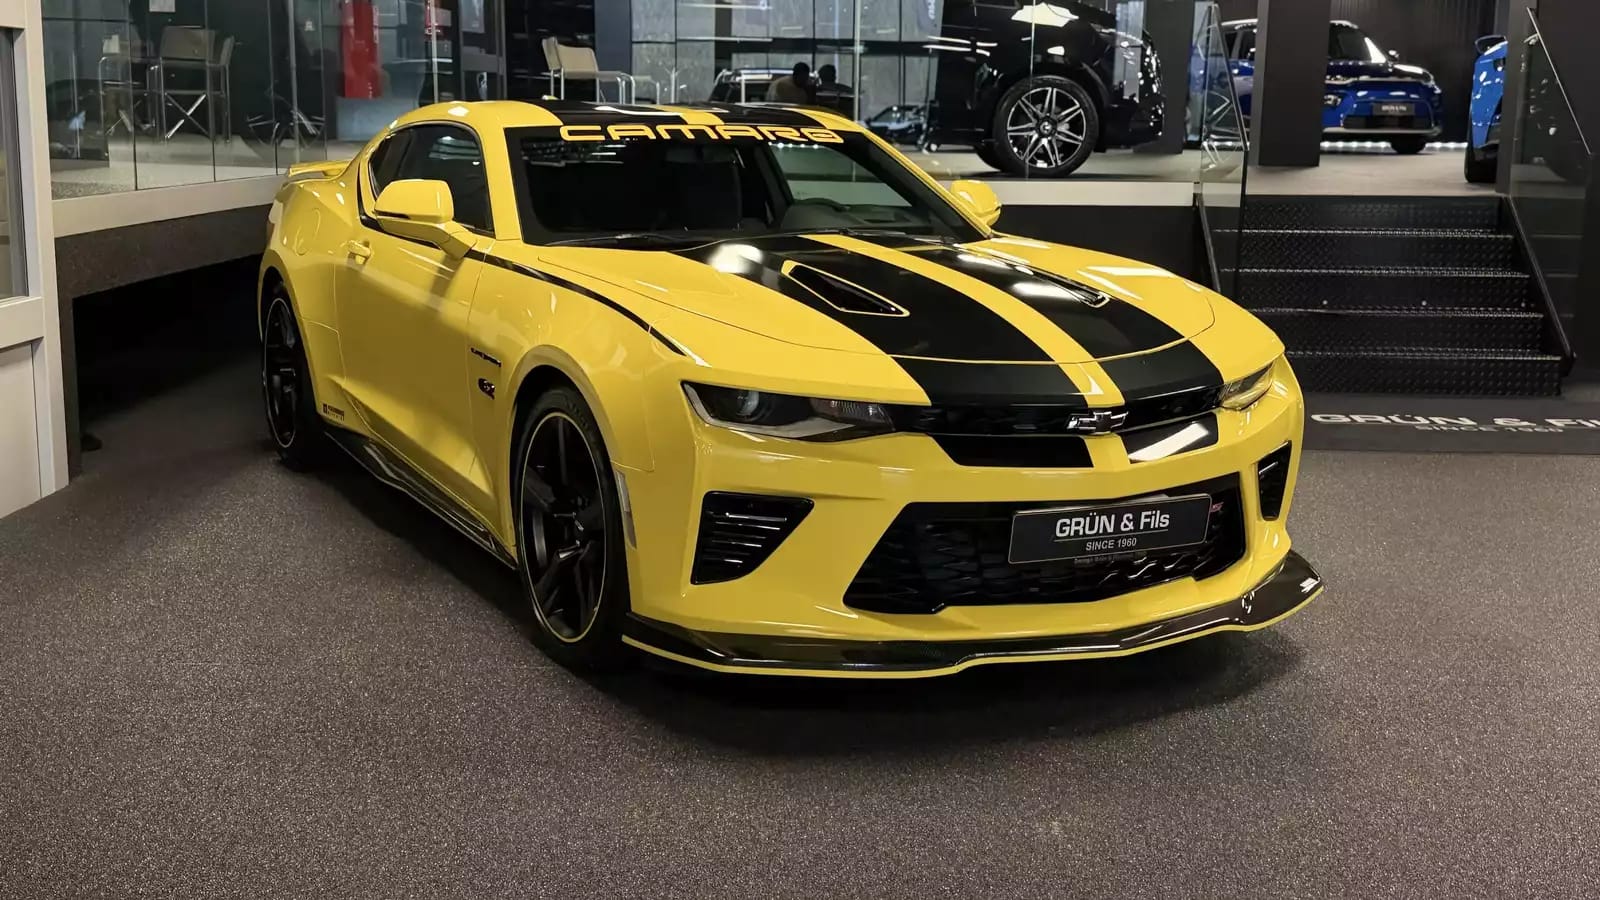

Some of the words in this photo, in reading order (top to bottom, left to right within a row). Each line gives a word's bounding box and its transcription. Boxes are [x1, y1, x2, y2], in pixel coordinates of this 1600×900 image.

[559, 124, 844, 143] CAMARO
[1311, 414, 1477, 426] GRÜN
[1494, 417, 1536, 427] &
[1055, 513, 1115, 538] GRÜN
[1120, 513, 1134, 532] &
[1139, 510, 1170, 530] Fils
[1085, 540, 1115, 551] SINCE
[1117, 537, 1137, 548] 1960
